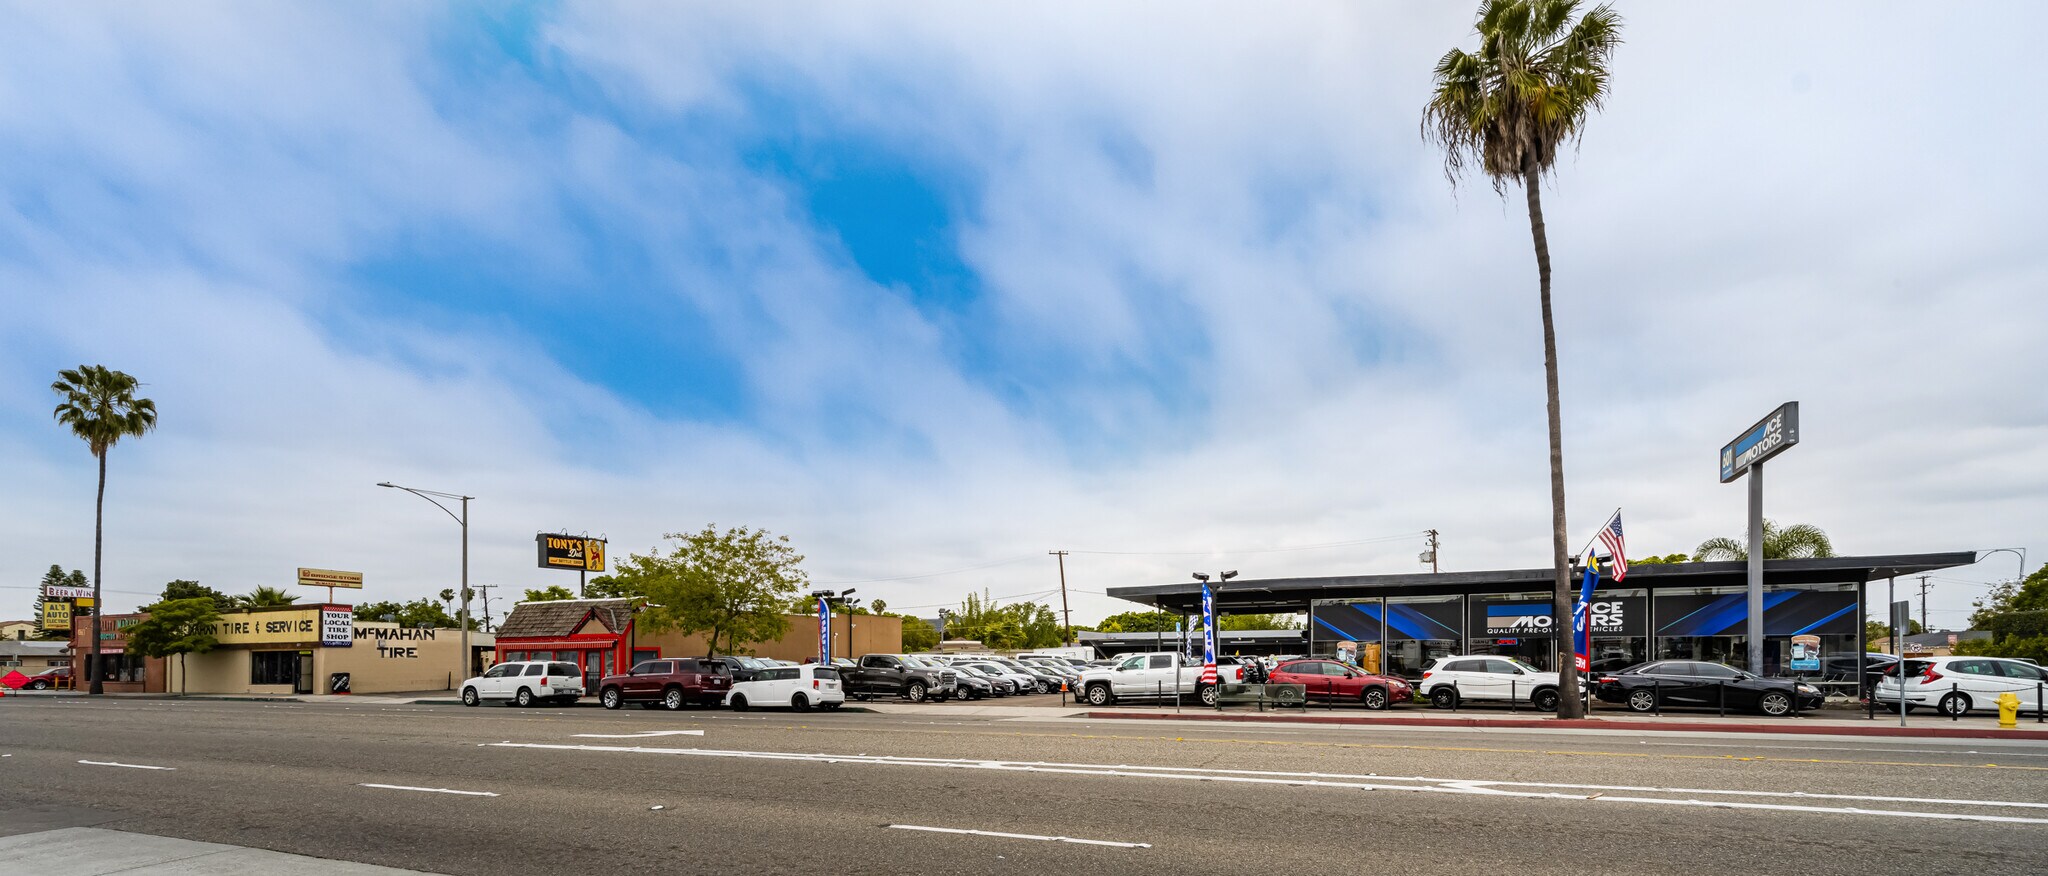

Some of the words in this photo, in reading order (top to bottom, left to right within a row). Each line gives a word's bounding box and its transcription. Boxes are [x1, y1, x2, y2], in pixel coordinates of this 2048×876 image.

[1763, 413, 1782, 438] ACE
[1743, 429, 1782, 464] MOTORS
[547, 537, 583, 551] TONY'S
[49, 587, 69, 596] BEER
[46, 611, 69, 619] AUTO
[1510, 614, 1624, 628] MORS
[223, 622, 250, 634] TIRE
[266, 620, 313, 633] SERVICE
[377, 647, 418, 658] TIRE
